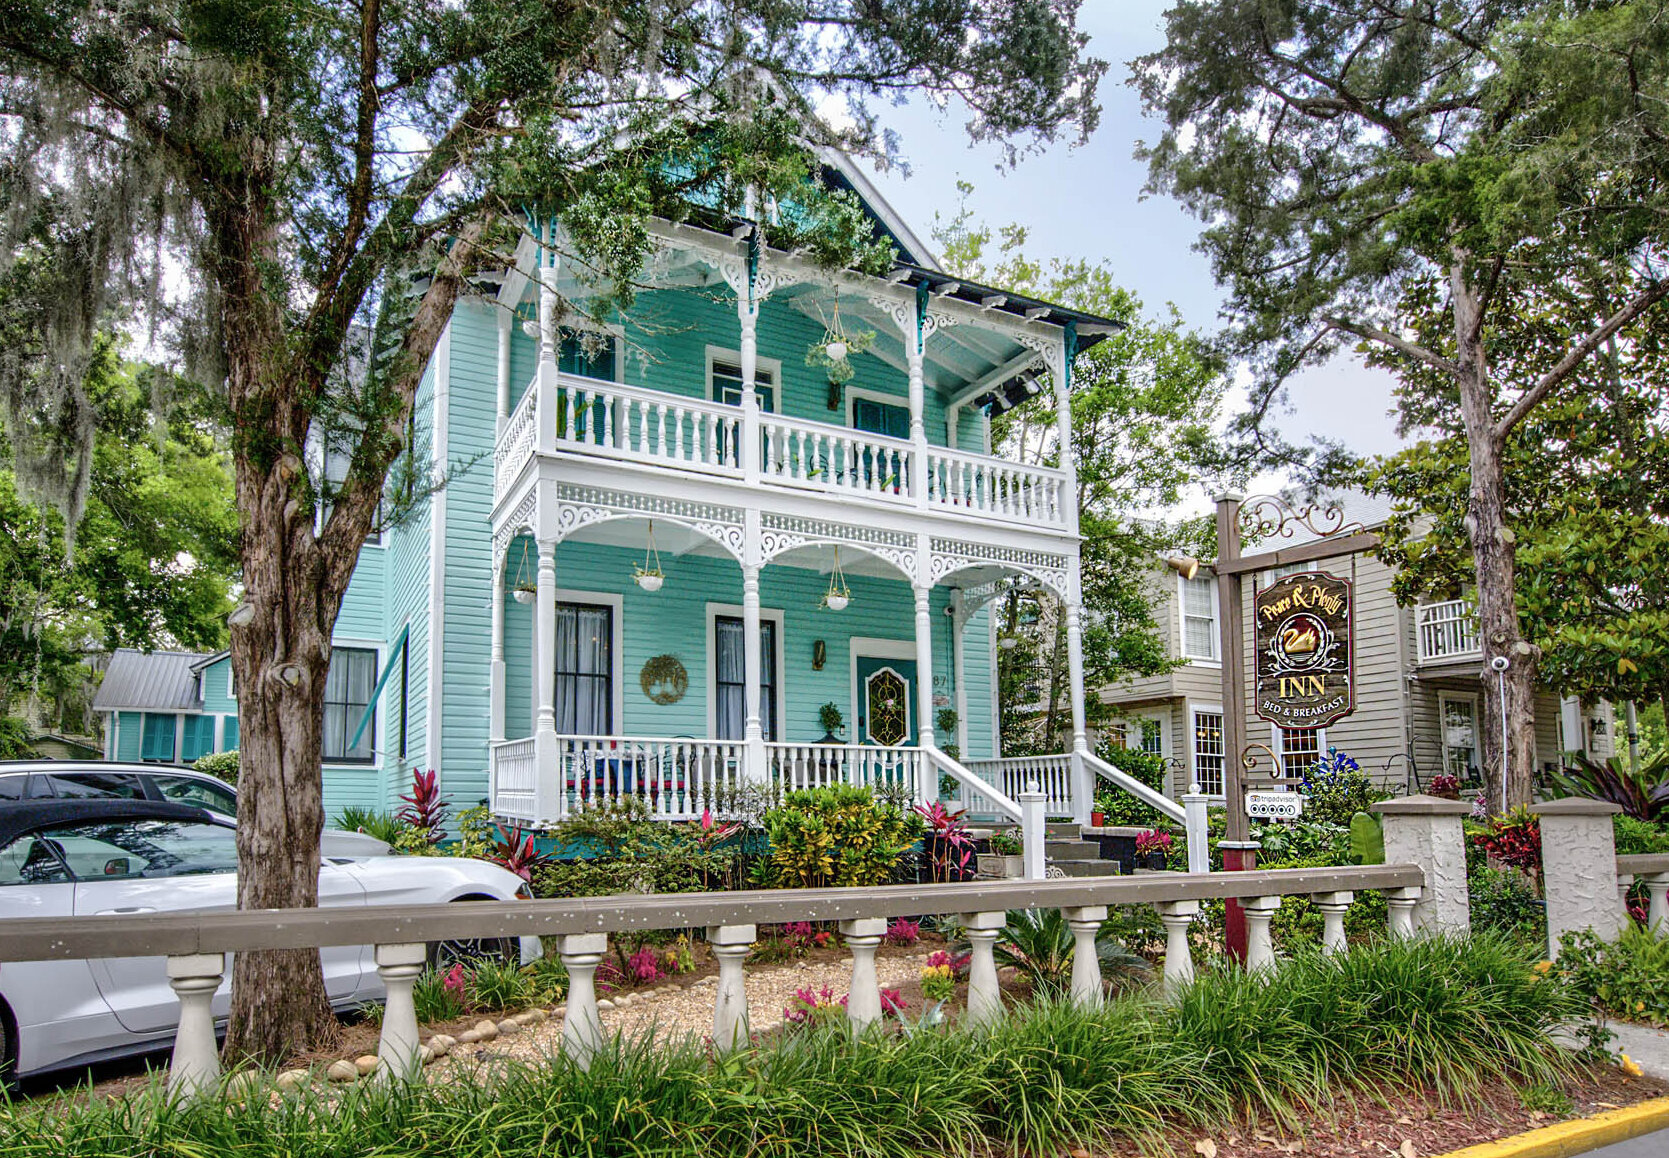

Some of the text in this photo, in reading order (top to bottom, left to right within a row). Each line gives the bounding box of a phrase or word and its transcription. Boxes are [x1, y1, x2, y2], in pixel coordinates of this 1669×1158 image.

[1259, 584, 1343, 621] Peace & Plenty
[933, 675, 946, 686] 87
[1279, 675, 1326, 698] INN
[1263, 696, 1344, 717] BED & BREAKFAST
